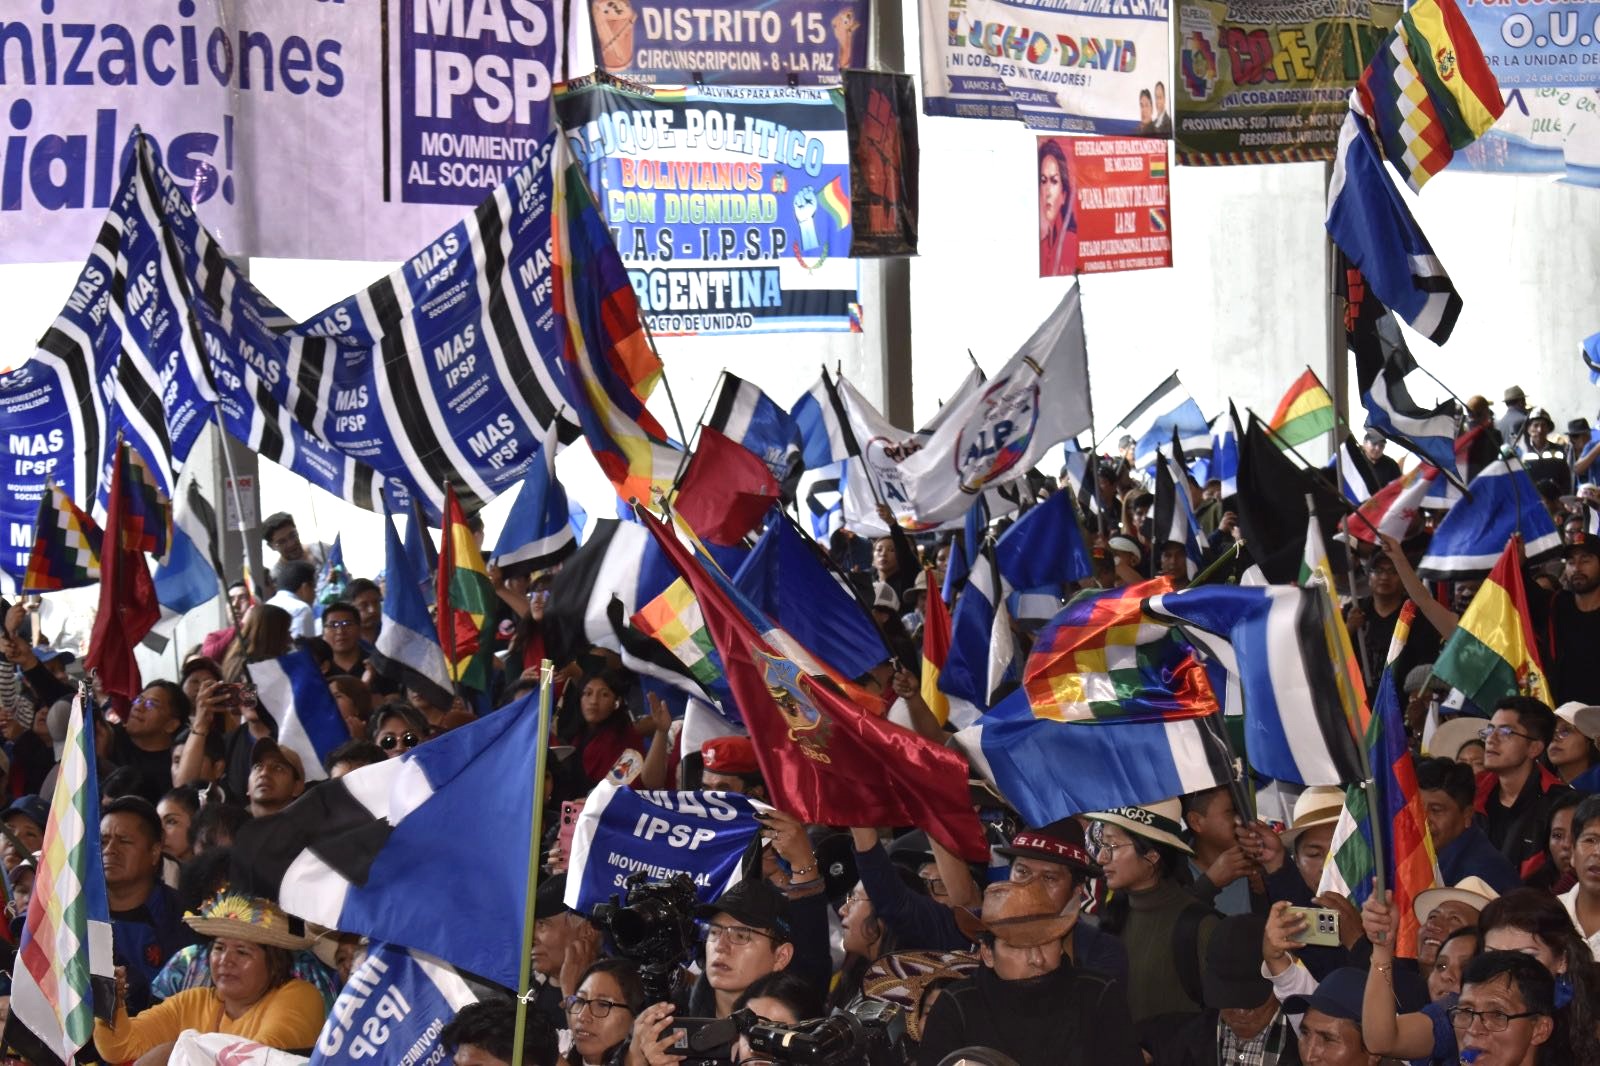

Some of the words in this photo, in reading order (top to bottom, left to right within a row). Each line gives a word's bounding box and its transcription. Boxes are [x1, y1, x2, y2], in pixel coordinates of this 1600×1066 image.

[414, 0, 548, 46] MAS
[642, 7, 782, 44] DISTRITO
[790, 13, 827, 44] 15
[637, 49, 761, 71] CIRCUNSCRIPCION
[770, 52, 780, 71] 8
[790, 53, 809, 71] LA
[811, 53, 834, 72] PAZ
[1057, 33, 1137, 73] DAVID
[1504, 55, 1520, 66] LA
[1524, 54, 1578, 66] UNIDAD
[1582, 53, 1600, 65] DE
[414, 49, 552, 125] IPSP
[698, 85, 744, 99] MALVINAS
[747, 89, 771, 99] PARA
[773, 88, 822, 99] ARGENTINA
[1555, 71, 1596, 82] Octubre
[421, 131, 538, 161] MOVIMIENTO
[685, 109, 825, 177] POLITICO
[408, 160, 436, 186] AL
[514, 143, 551, 197] MAS
[620, 158, 763, 191] BOLIVIANOS
[607, 189, 656, 224] CON
[664, 191, 778, 225] DIGNIDAD
[412, 232, 460, 279] MAS
[614, 228, 674, 261] .A.S
[68, 266, 104, 314] MAS
[425, 259, 458, 291] IPSP
[627, 270, 783, 311] RGENTINA
[421, 283, 460, 313] MOVIMIENTO
[460, 279, 469, 288] AL
[428, 290, 467, 319] SOCIALISMO
[531, 276, 553, 307] IPS
[648, 315, 681, 331] ACTO
[685, 316, 700, 330] DE
[703, 314, 753, 331] UNIDAD
[239, 338, 280, 384] MAS
[434, 323, 476, 371] MAS
[445, 354, 476, 389] IPSP
[335, 385, 369, 411] MAS
[448, 379, 482, 409] MOVIMIENTO
[481, 373, 490, 383] AL
[455, 384, 489, 414] SOCIALISMO
[335, 414, 367, 432] IPSP
[467, 413, 515, 458] MAS
[9, 428, 64, 456] MAS
[488, 438, 519, 470] IPSP
[15, 457, 57, 476] IPSP
[7, 483, 46, 491] MOVIMIEN
[14, 492, 43, 501] SOCIAL
[635, 790, 738, 821] MAS
[633, 813, 716, 851] IPSP
[694, 872, 712, 887] AL
